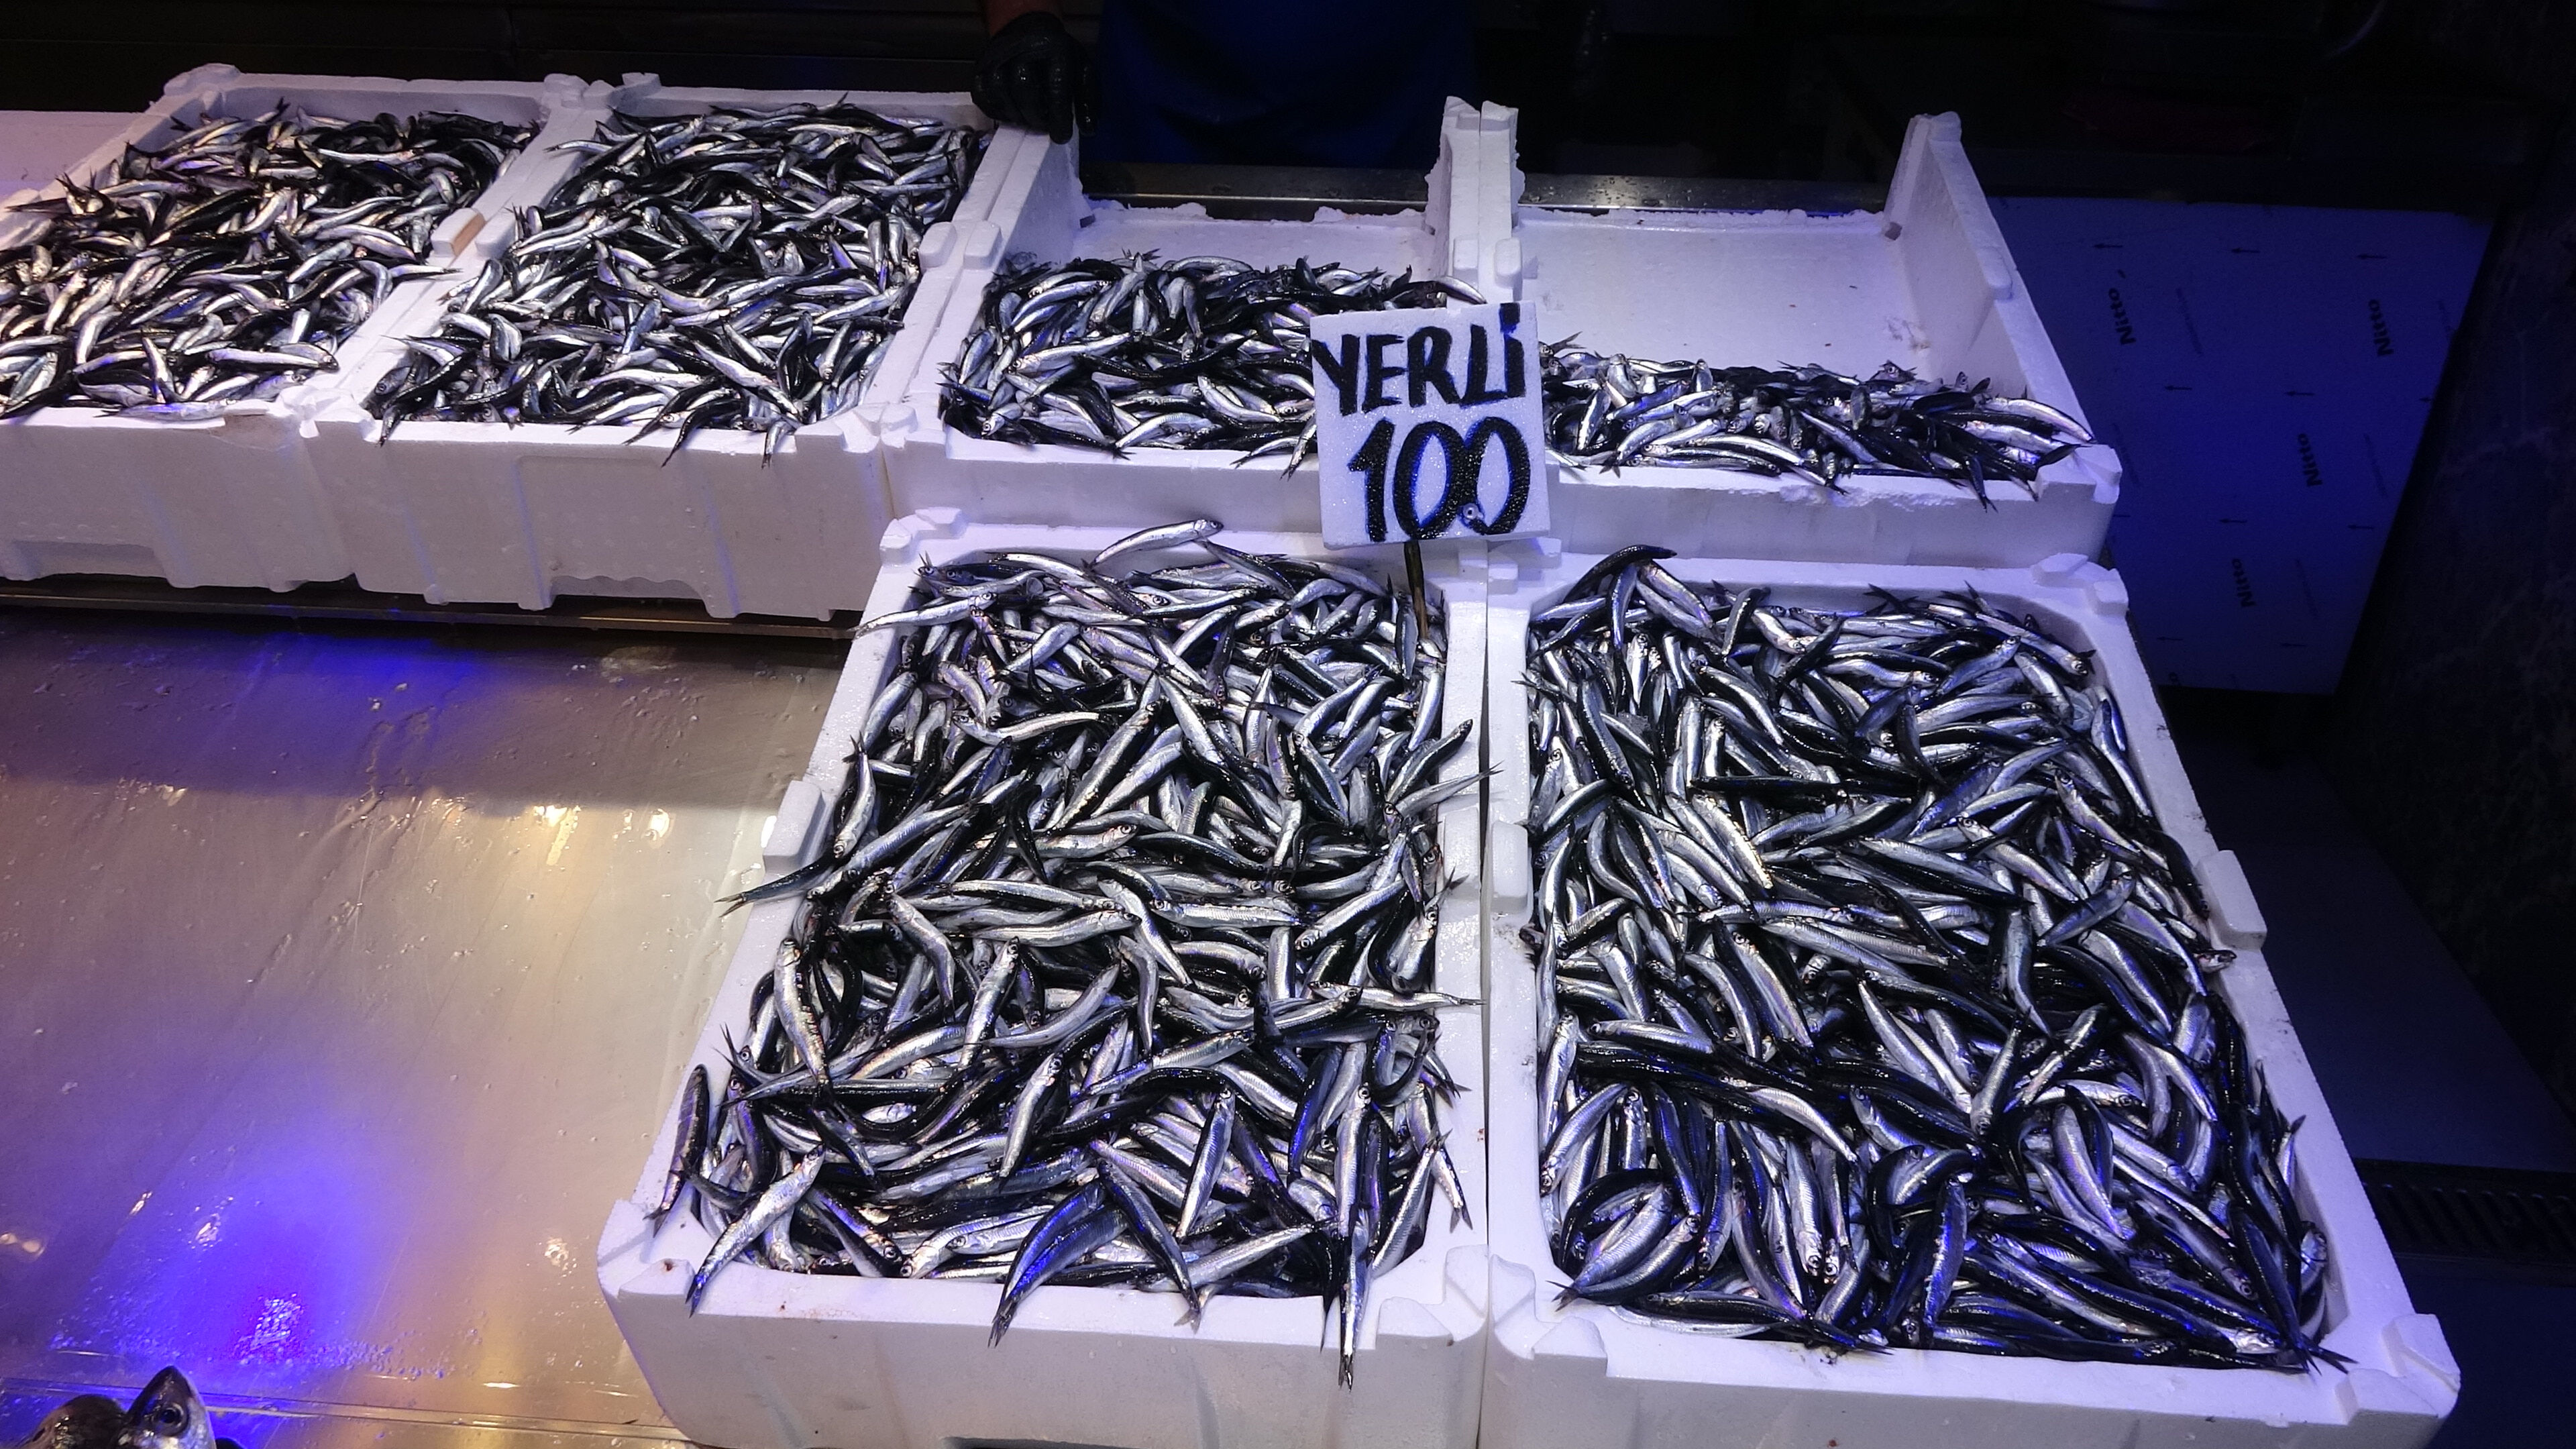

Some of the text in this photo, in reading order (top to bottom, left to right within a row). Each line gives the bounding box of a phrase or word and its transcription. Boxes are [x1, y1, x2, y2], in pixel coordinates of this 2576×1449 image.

[2108, 288, 2136, 345] Nitto
[2368, 299, 2394, 357] Nitto
[1347, 417, 1530, 542] 100
[2298, 433, 2323, 486] Nitto
[2232, 557, 2256, 608] Nitto
